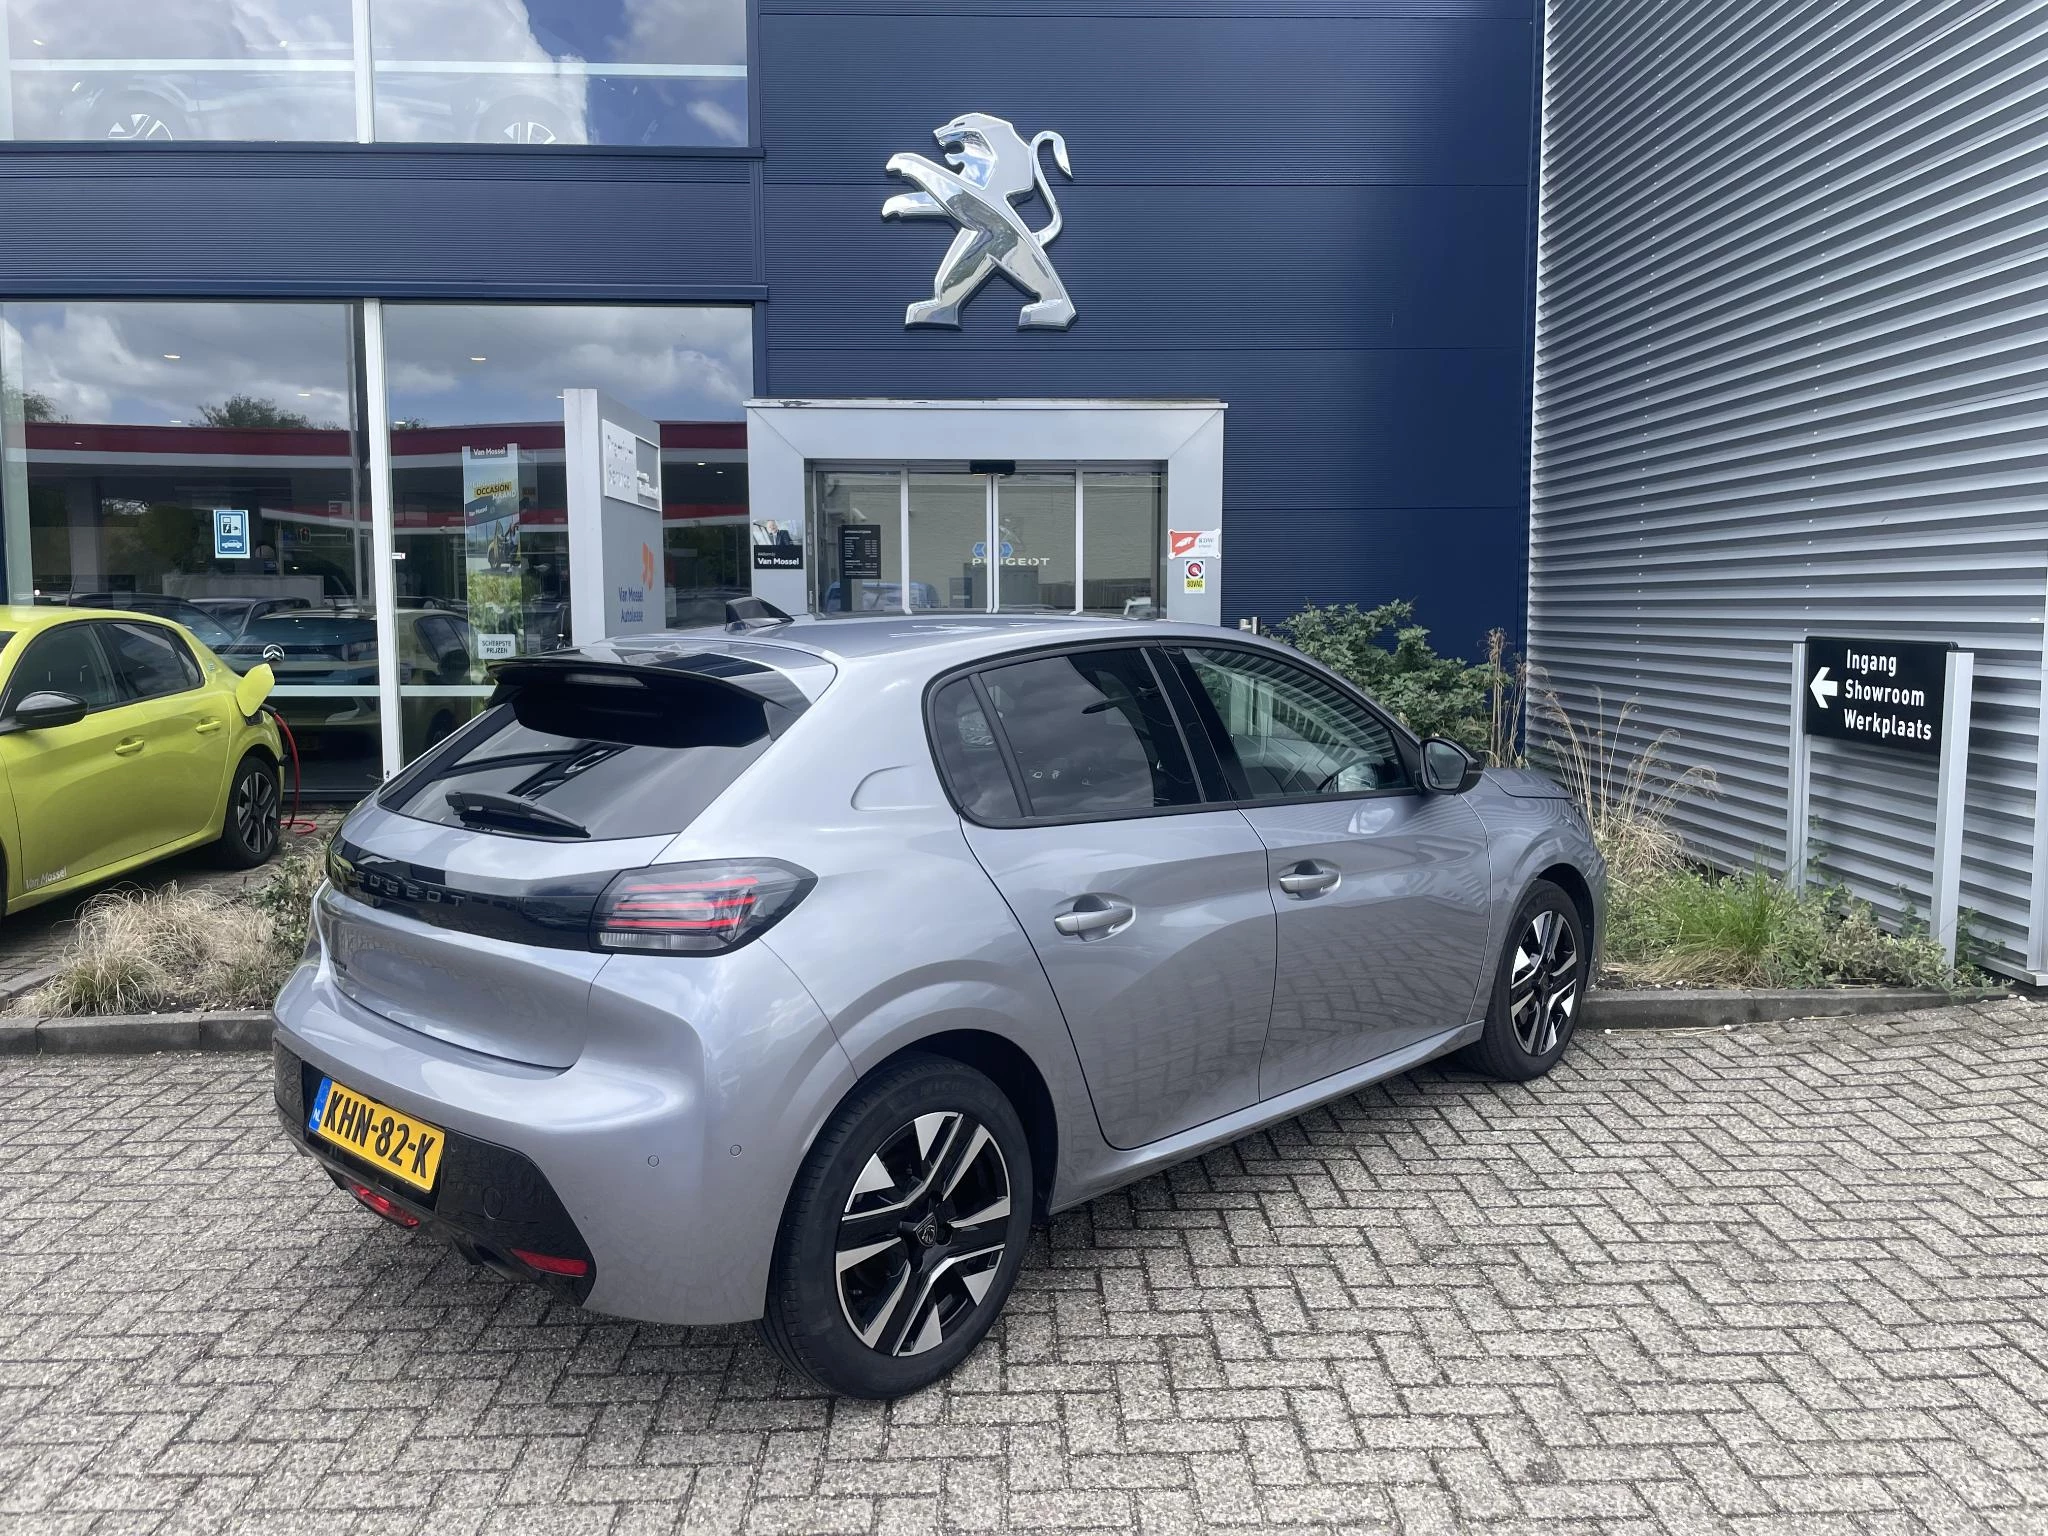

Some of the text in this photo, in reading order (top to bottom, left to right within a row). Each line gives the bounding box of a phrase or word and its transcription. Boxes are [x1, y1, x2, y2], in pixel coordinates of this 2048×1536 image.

[486, 447, 506, 455] Mossel
[476, 484, 510, 496] OCCASION
[757, 557, 800, 565] Van Mossel
[972, 557, 1051, 566] PGEOT
[618, 586, 644, 602] Van Mossel
[1846, 648, 1897, 677] Ingang
[1844, 678, 1925, 707] Showroom
[1843, 708, 1932, 741] Werkplaats
[25, 865, 67, 890] Van Mossel
[323, 1090, 436, 1179] KHN-82-K
